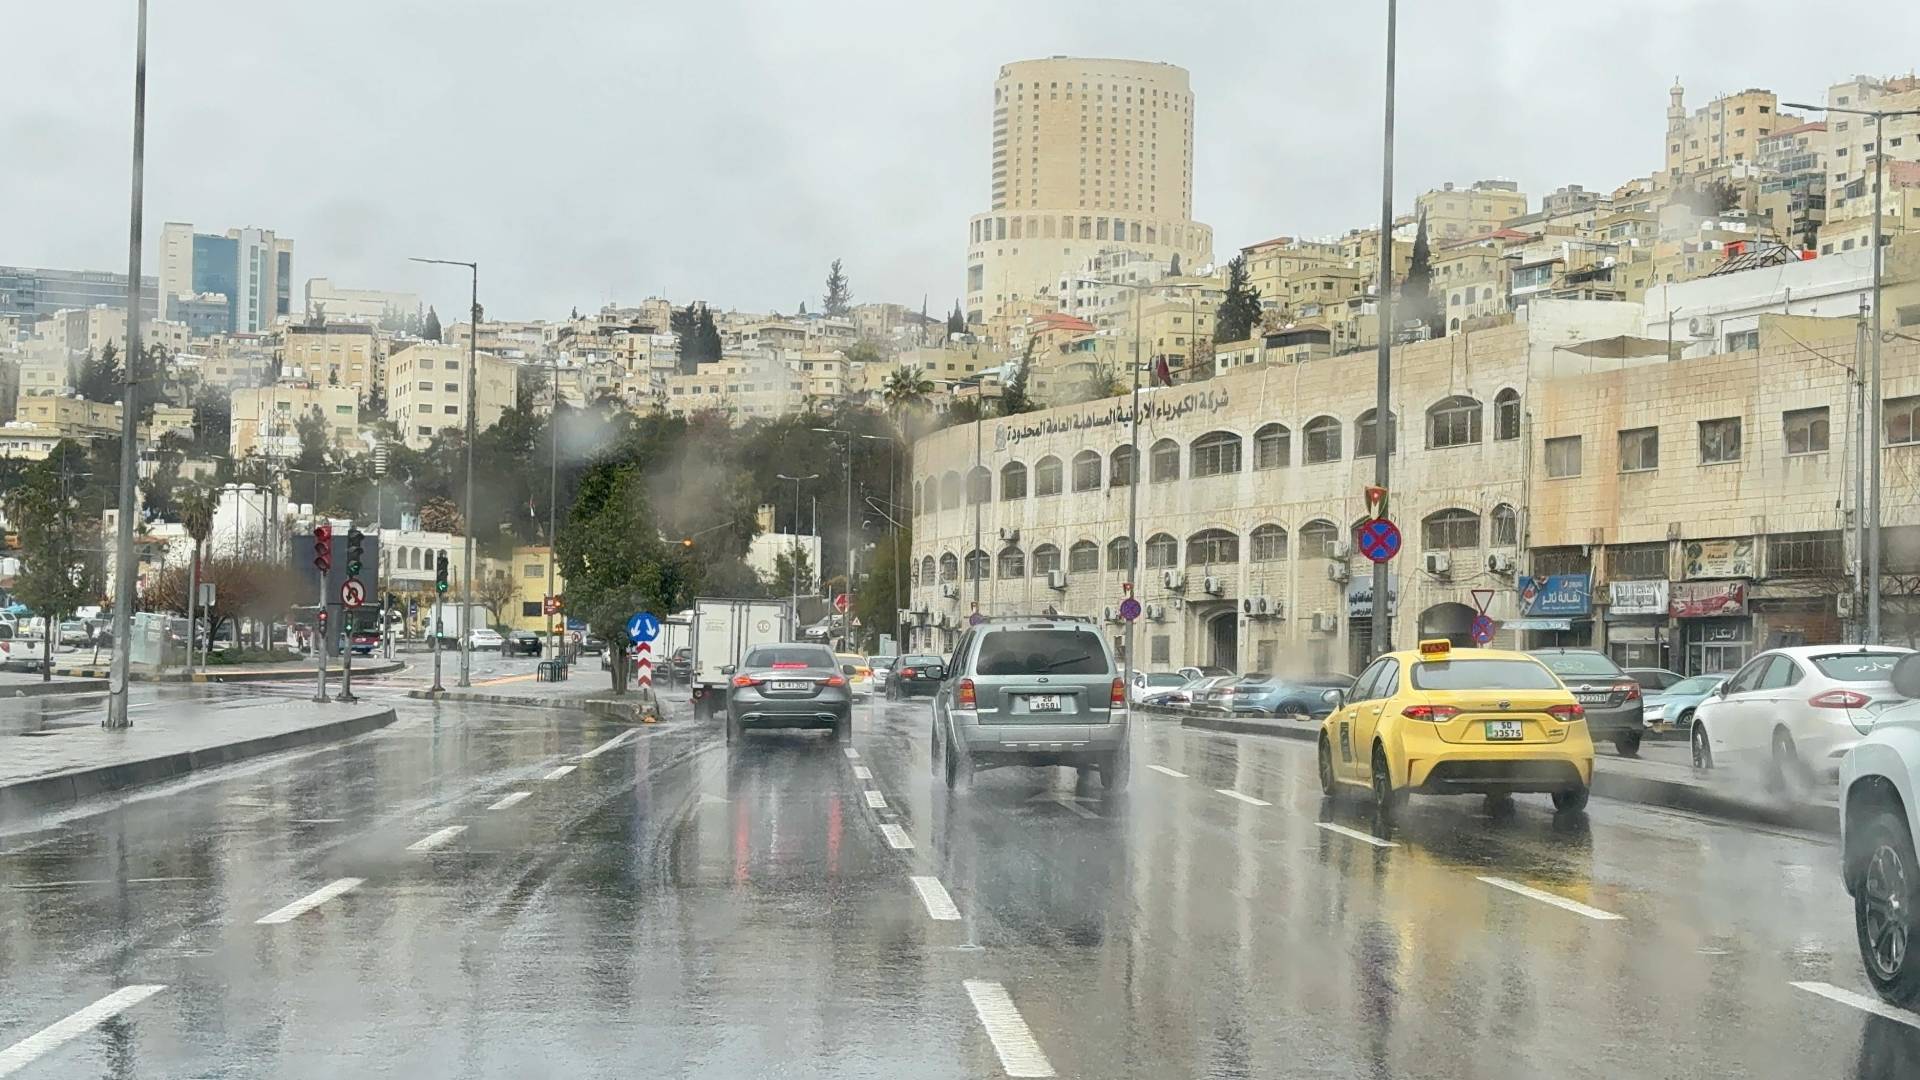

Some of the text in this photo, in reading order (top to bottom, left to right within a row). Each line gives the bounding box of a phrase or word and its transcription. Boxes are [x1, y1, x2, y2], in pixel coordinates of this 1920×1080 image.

[1117, 400, 1155, 427] الارنية
[1157, 393, 1199, 421] الكهرباء
[1199, 388, 1229, 415] شركة
[1007, 420, 1046, 445] المحدودة
[1046, 416, 1073, 434] العامة
[1501, 721, 1512, 730] 50
